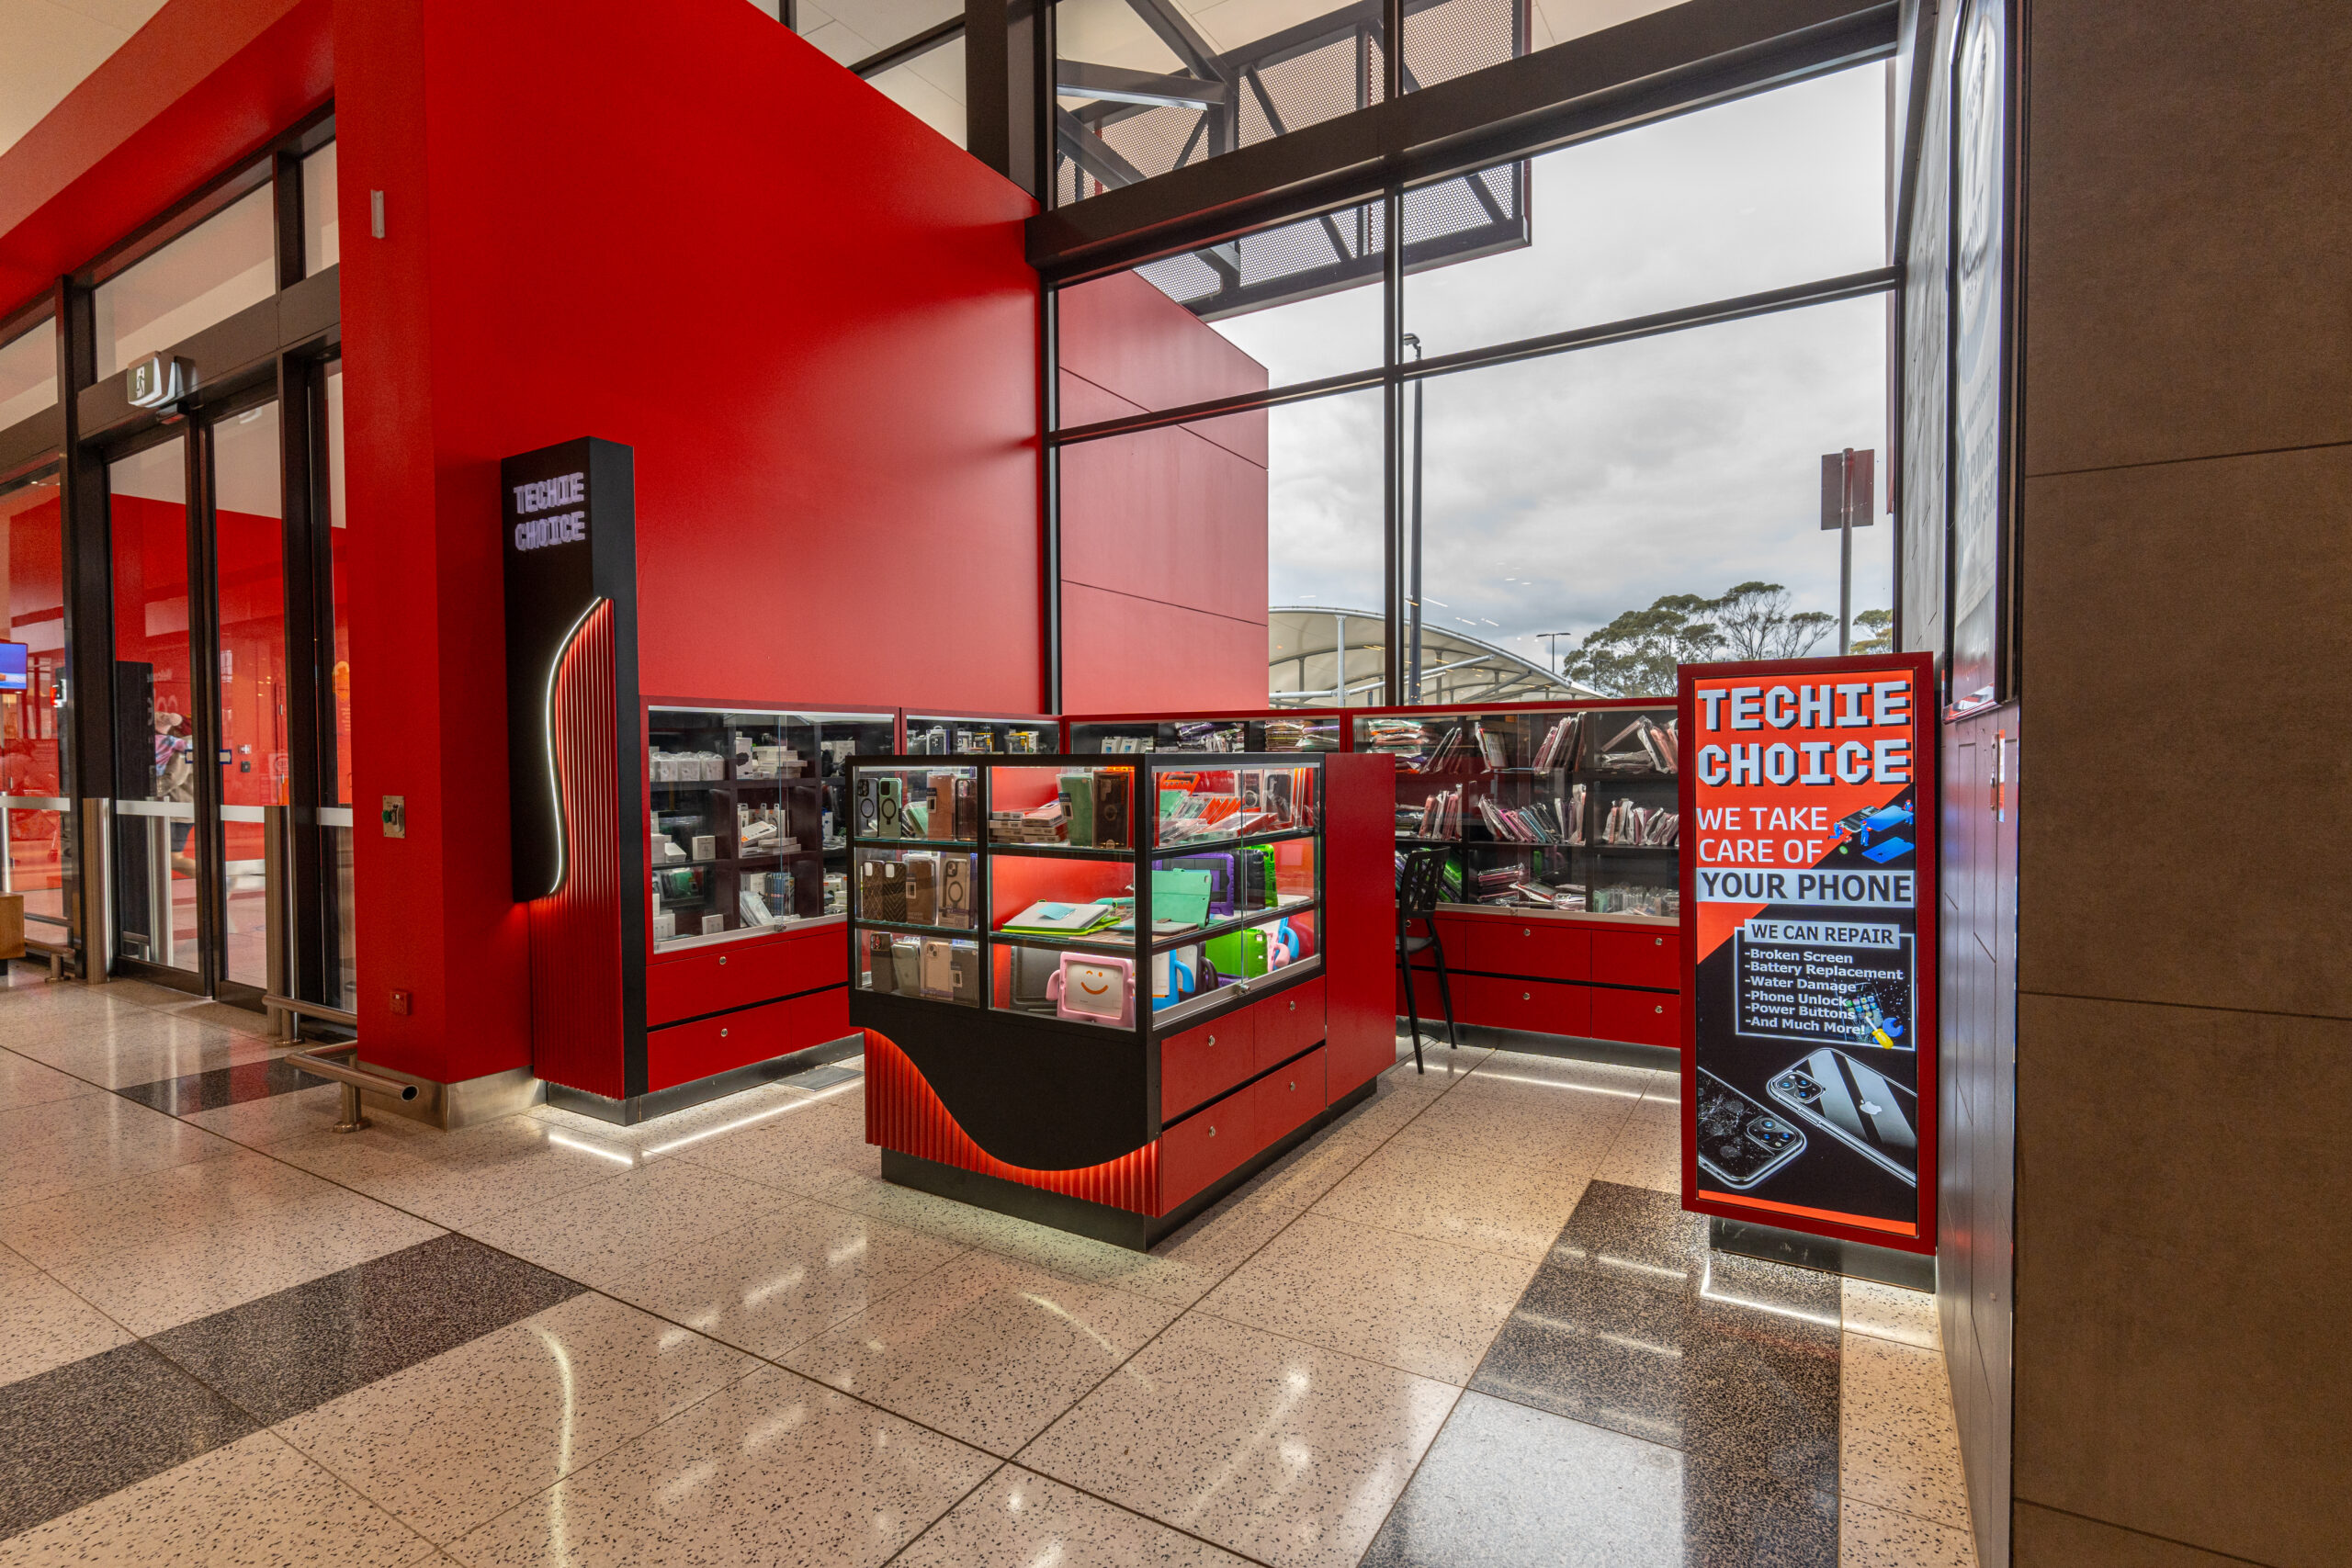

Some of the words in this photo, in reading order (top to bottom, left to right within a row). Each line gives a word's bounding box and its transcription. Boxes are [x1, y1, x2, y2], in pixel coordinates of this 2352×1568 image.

[1970, 416, 1995, 491] POINTS
[514, 471, 584, 514] TECHIE
[1970, 486, 1984, 540] YOU
[514, 511, 585, 552] CHOICE
[1697, 680, 1911, 732] TECHIE
[1697, 739, 1912, 788] CHOICE
[1696, 807, 1741, 830] WE
[1748, 807, 1828, 831] TAKE
[1699, 839, 1774, 863] CARE
[1783, 839, 1823, 863] OF
[1700, 872, 1789, 899] YOUR
[1798, 874, 1912, 902] PHONE
[1751, 923, 1779, 939] WE
[1783, 925, 1818, 942] CAN
[1825, 926, 1894, 944] REPAIR
[1803, 951, 1853, 964] Screen
[1805, 964, 1905, 980] Replacement
[1796, 978, 1857, 994] Damage
[1798, 993, 1849, 1007] Unlock
[1798, 1006, 1856, 1020] Buttons
[1781, 1018, 1820, 1032] Much
[1824, 1021, 1866, 1035] More!
